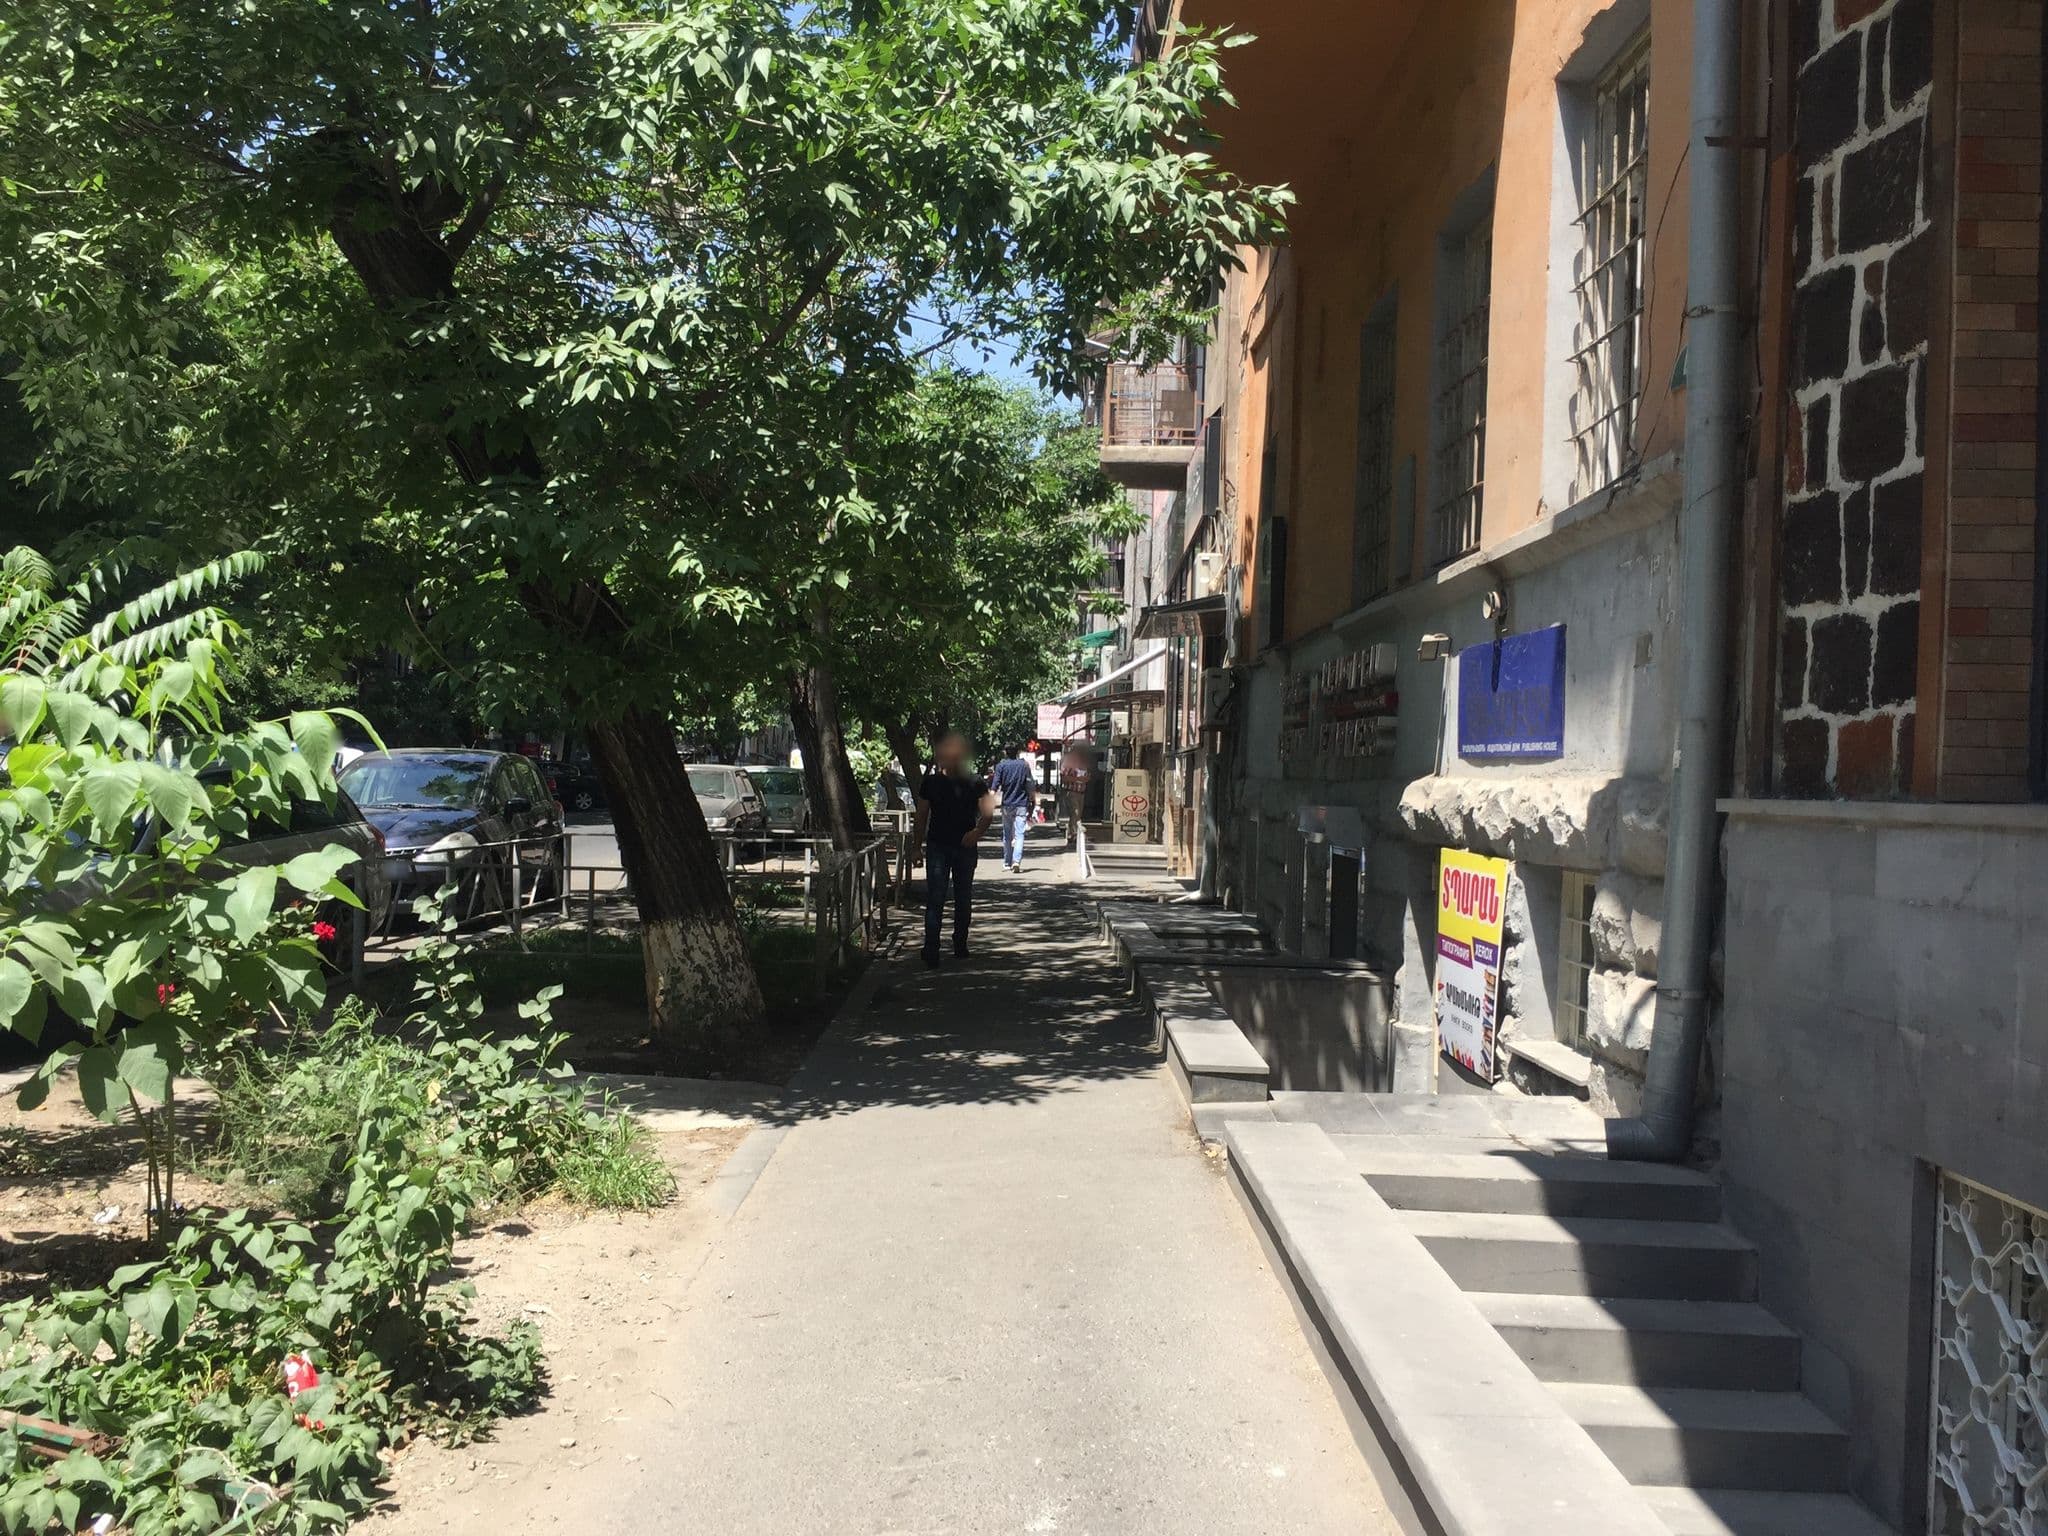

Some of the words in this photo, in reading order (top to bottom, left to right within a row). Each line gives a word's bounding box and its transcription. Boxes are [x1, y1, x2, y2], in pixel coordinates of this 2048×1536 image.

[1443, 867, 1499, 924] ՏՊԱՐԱՆ
[1441, 939, 1470, 962] ТИПОГРАФИЯ
[1475, 943, 1493, 962] XEROX
